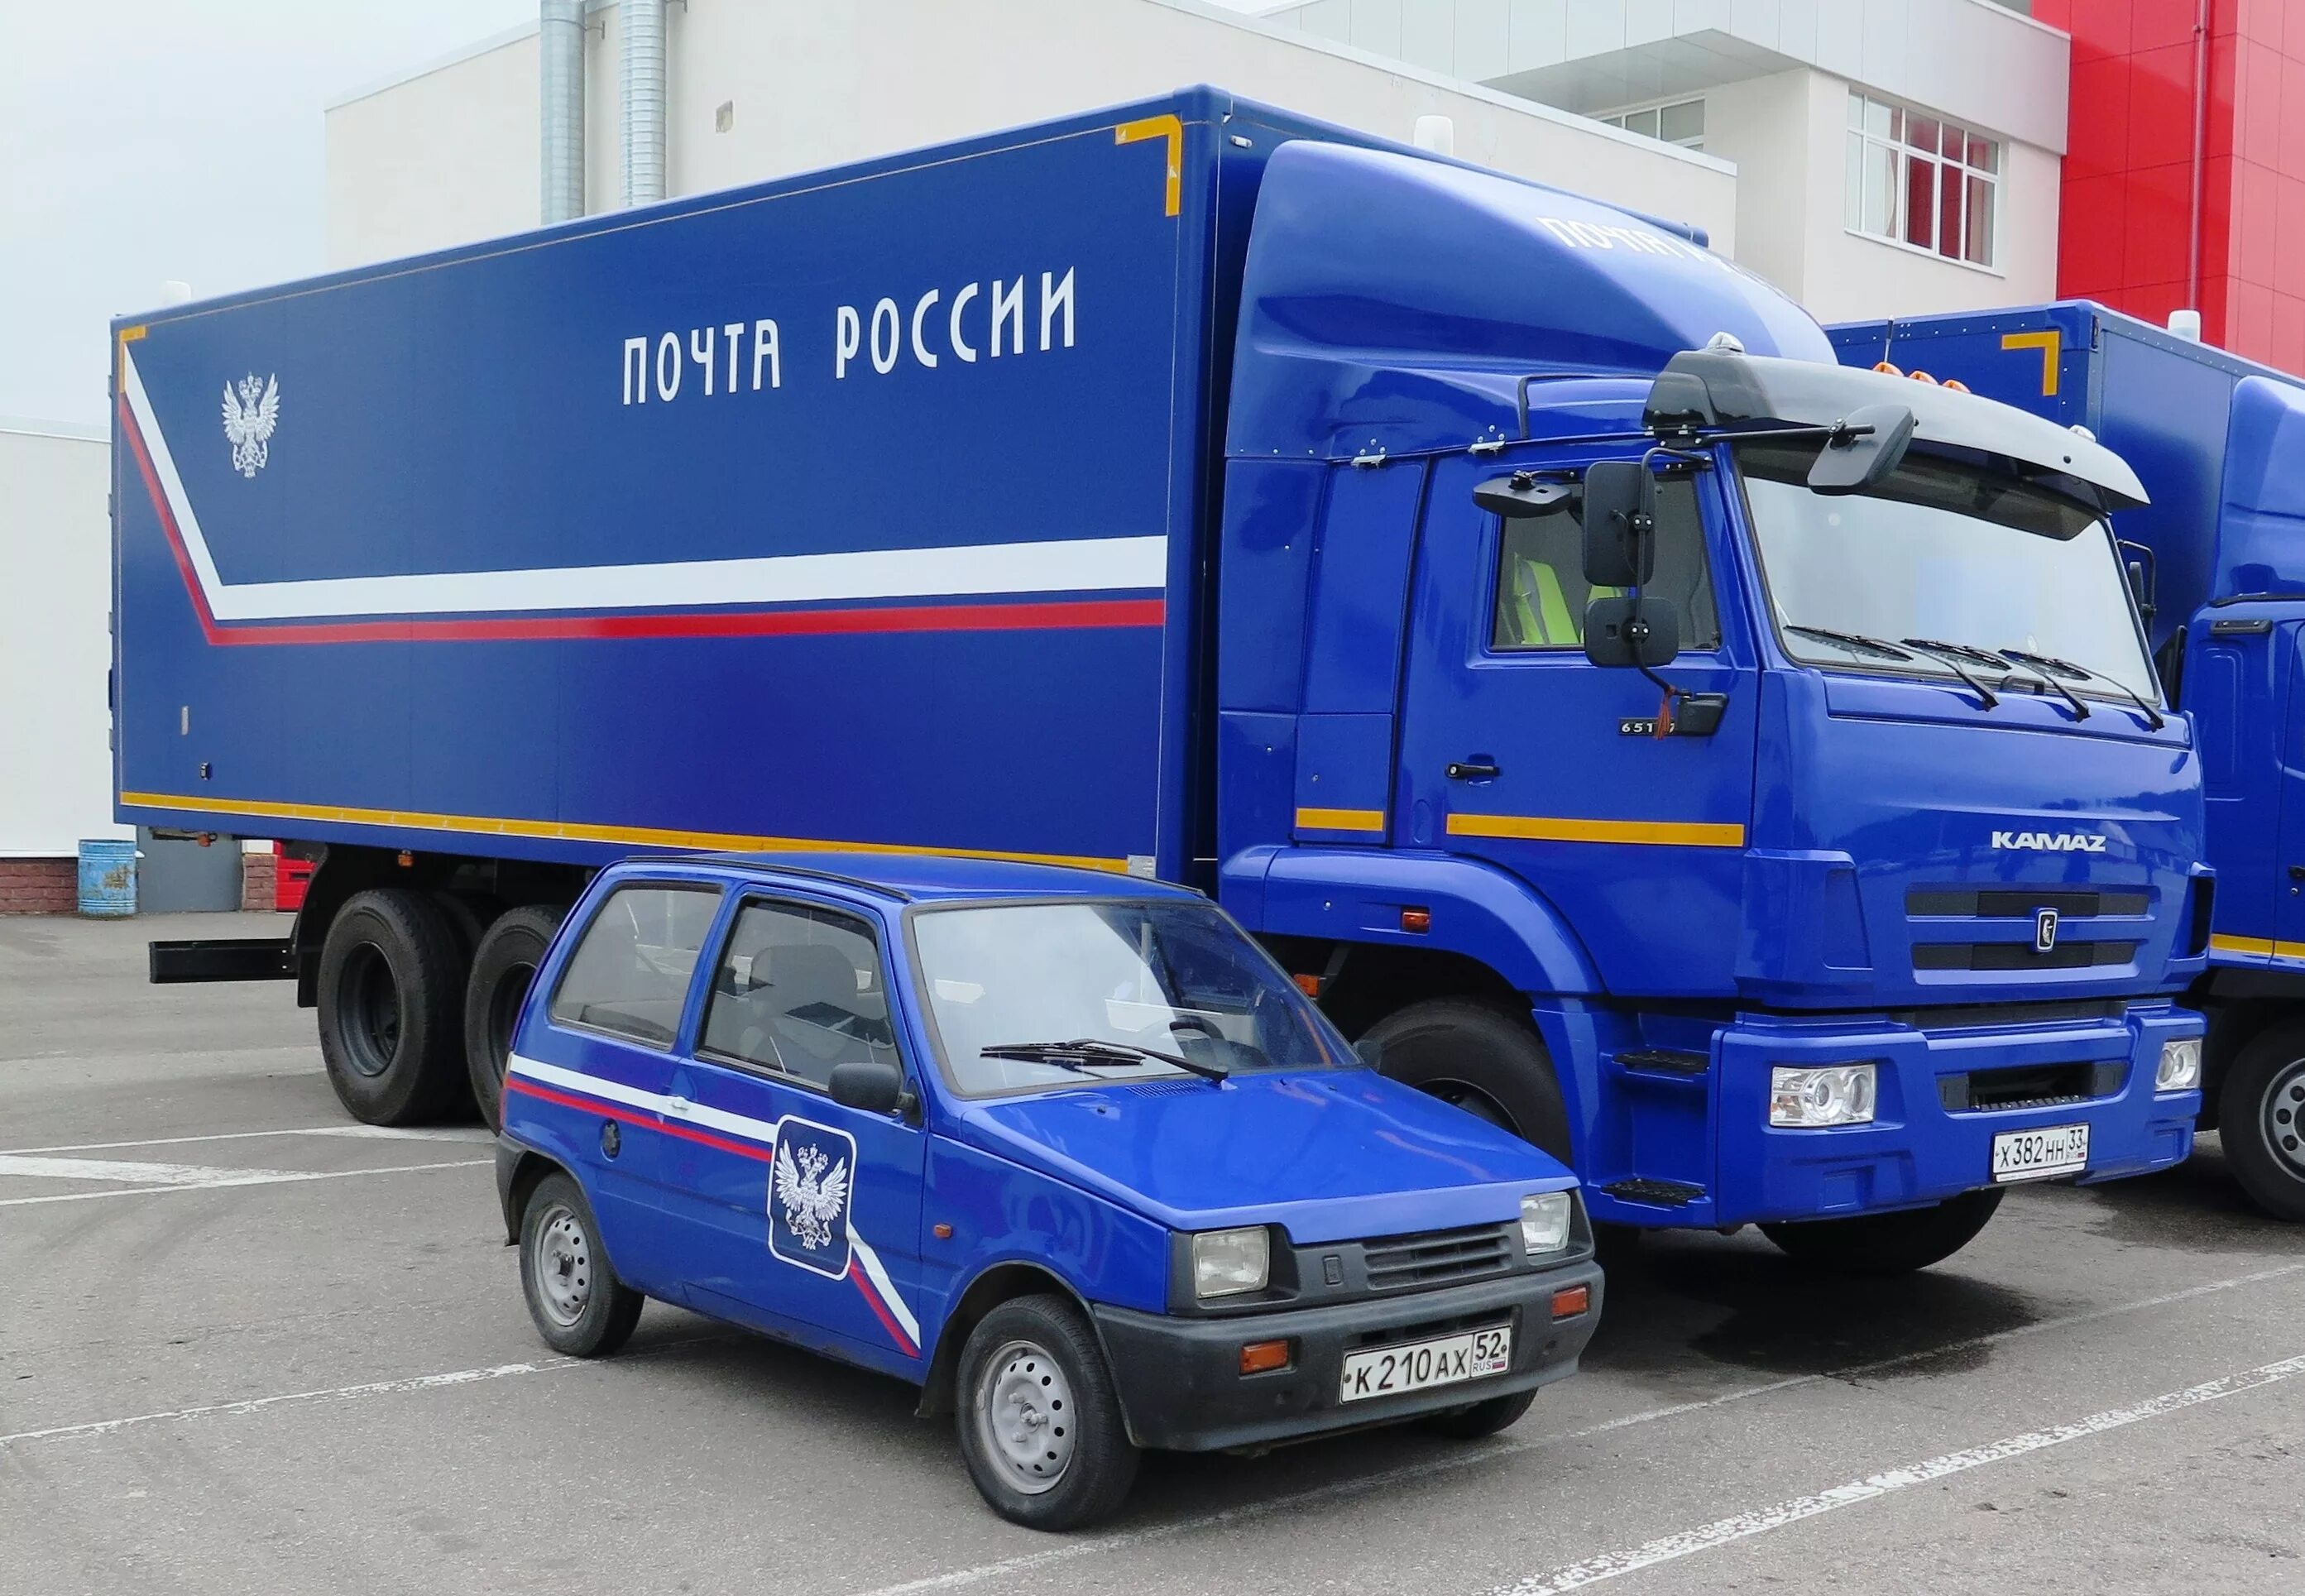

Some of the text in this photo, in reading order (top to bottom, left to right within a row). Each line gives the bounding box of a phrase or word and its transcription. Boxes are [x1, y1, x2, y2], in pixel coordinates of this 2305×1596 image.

[623, 266, 1075, 405] ПОЧТА РОССИИ
[1622, 722, 1675, 733] 6517
[1992, 832, 2106, 851] KAMAZ
[2068, 1129, 2083, 1150] 33
[1475, 1332, 1501, 1360] 52
[1473, 1361, 1492, 1373] RUS
